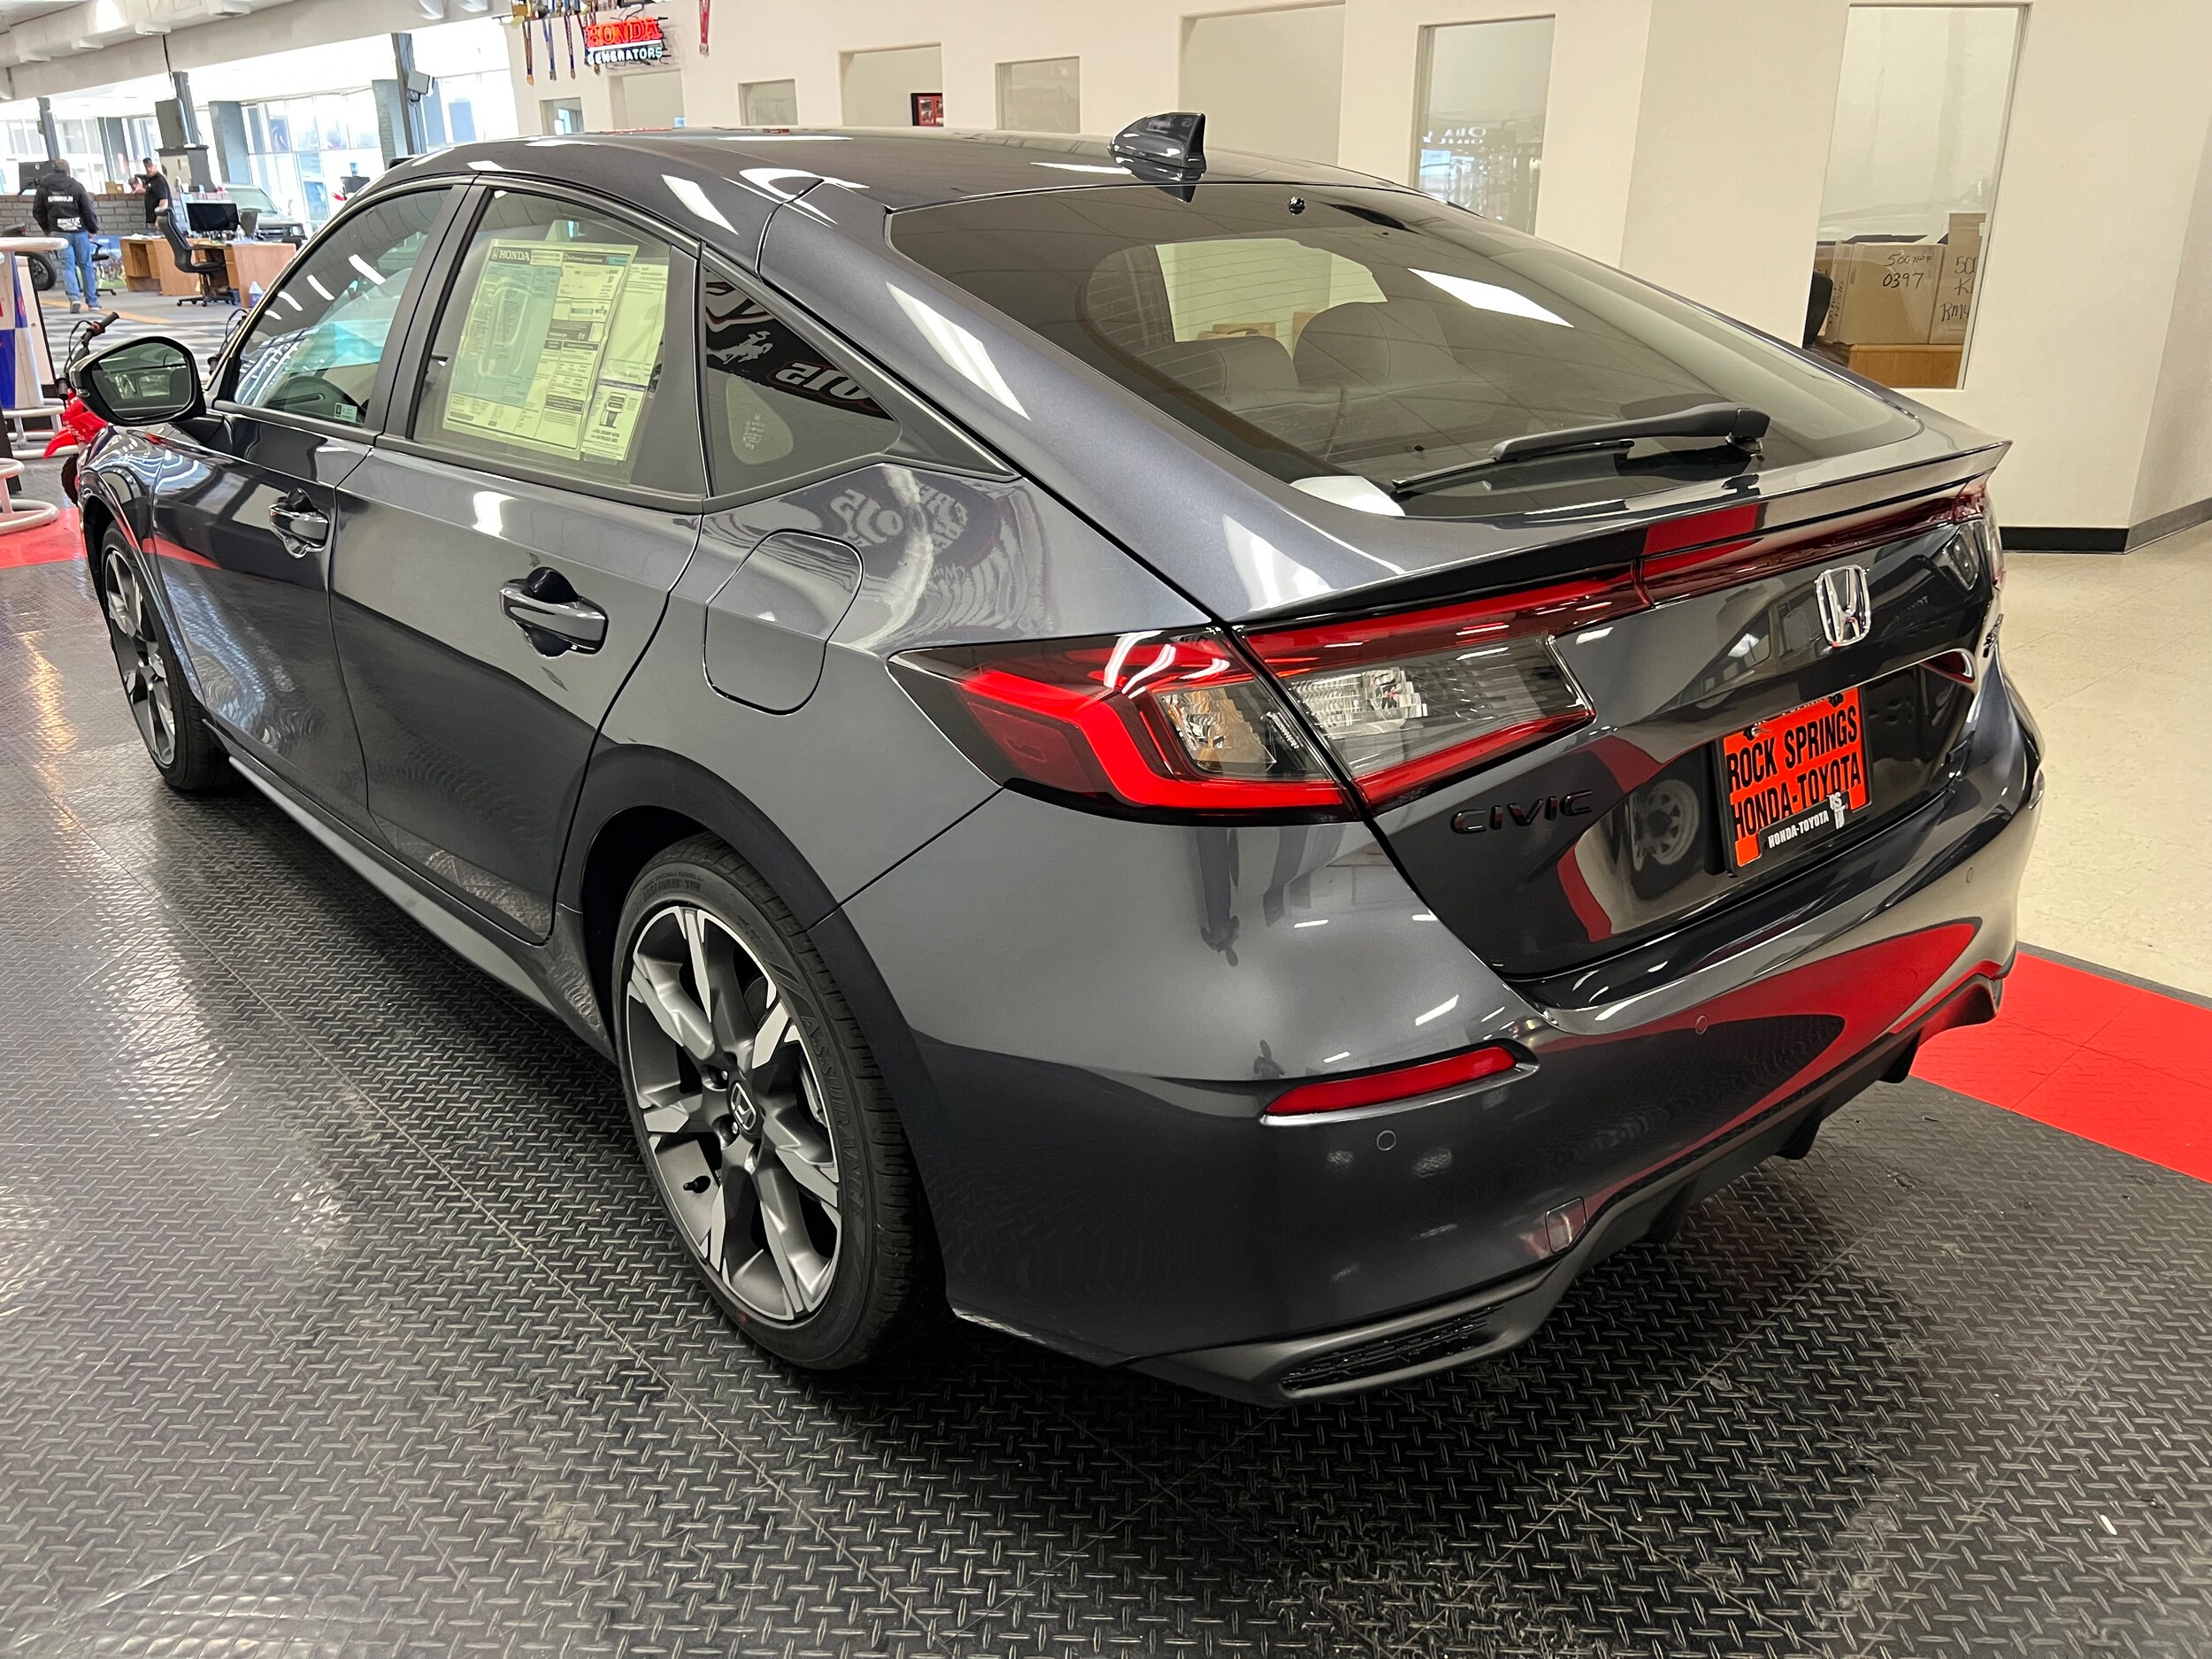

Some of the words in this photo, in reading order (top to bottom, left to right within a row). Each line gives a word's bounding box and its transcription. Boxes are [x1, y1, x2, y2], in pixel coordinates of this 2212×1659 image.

[586, 17, 663, 48] HONDA
[587, 46, 663, 65] GENERATORS
[498, 249, 531, 262] HONDA
[1882, 272, 1924, 291] 0397
[1726, 736, 1778, 794] ROCK
[1784, 704, 1858, 770] SPRINGS
[1450, 789, 1593, 834] CIVIC
[1731, 751, 1862, 841] HONDA-TOYOTA
[1767, 810, 1830, 849] HONDA-TOYOTA
